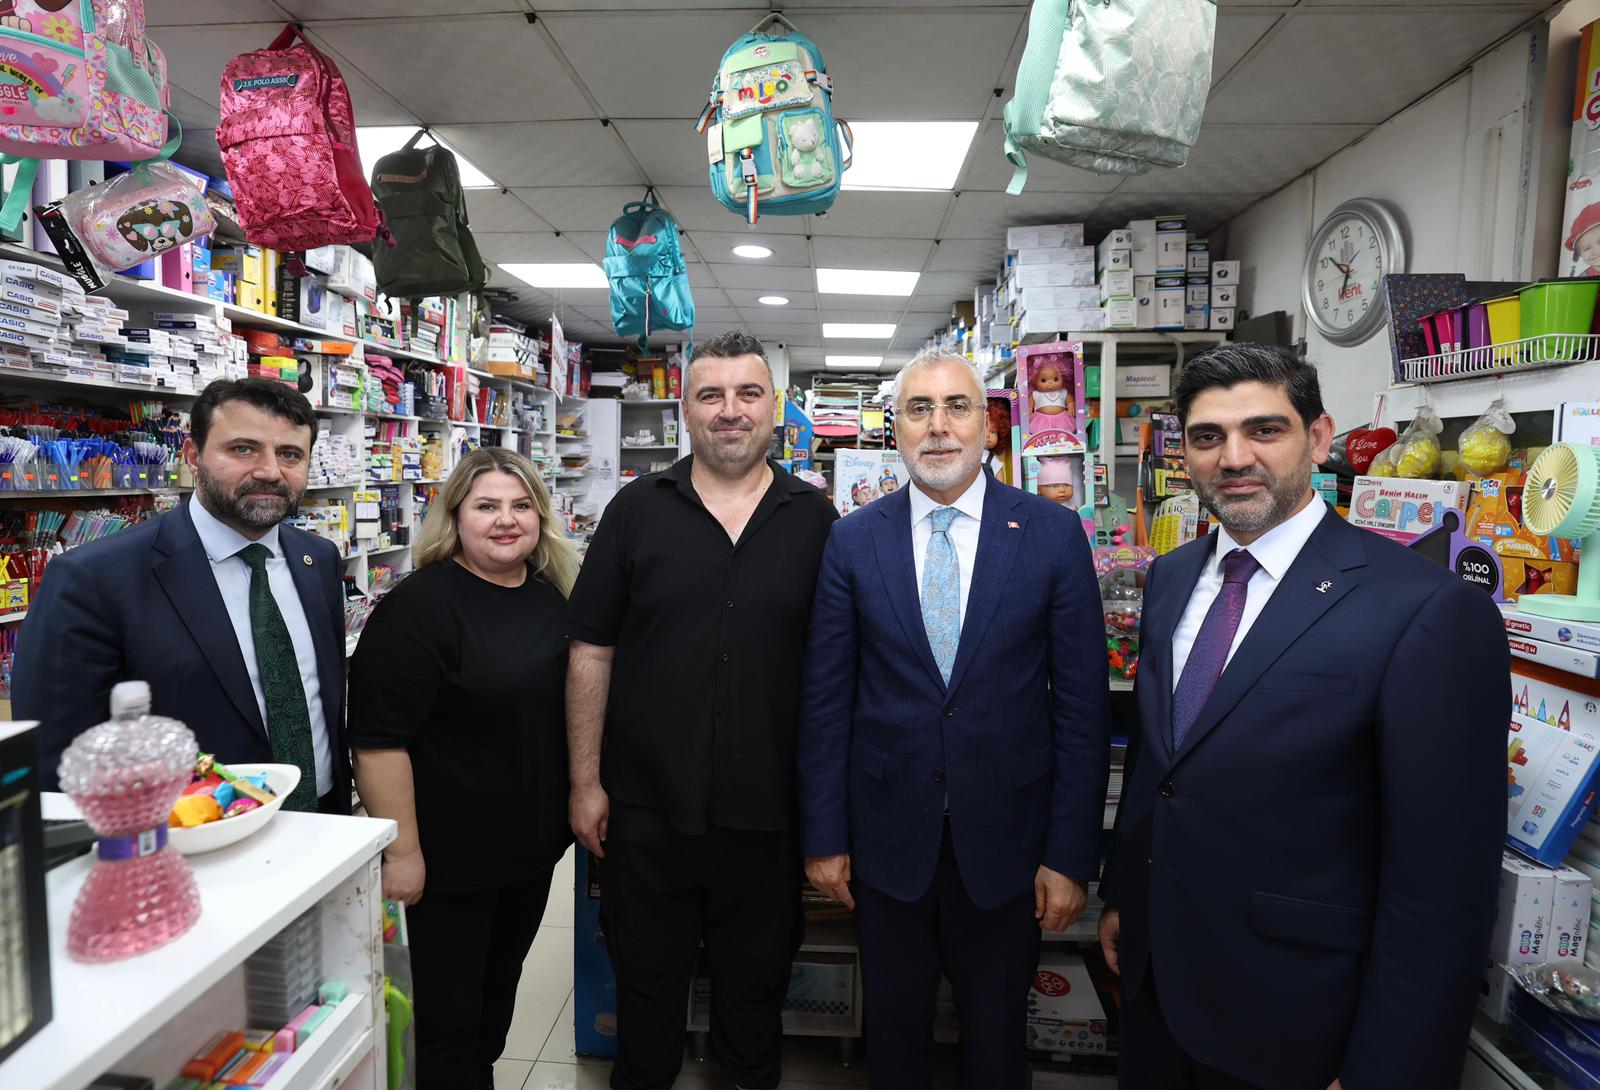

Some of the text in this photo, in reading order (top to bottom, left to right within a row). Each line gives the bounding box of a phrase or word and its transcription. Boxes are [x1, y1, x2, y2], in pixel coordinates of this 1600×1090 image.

[1340, 226, 1350, 240] 12
[1358, 226, 1363, 238] 1
[1328, 240, 1336, 251] 11
[1369, 236, 1376, 250] 2
[1319, 256, 1329, 269] 10
[1376, 256, 1382, 269] 3
[40, 270, 62, 282] CASIO
[6, 277, 34, 290] CASIO
[1317, 280, 1324, 292] 9
[1371, 280, 1378, 290] 4
[7, 291, 34, 303] CASIO
[1323, 298, 1330, 310] 8
[1361, 298, 1368, 312] 5
[1333, 308, 1340, 322] 7
[1347, 309, 1354, 322] 6
[80, 332, 104, 340] CASIO
[840, 455, 875, 470] Disney
[1470, 478, 1499, 490] ARIOCA
[1174, 505, 1184, 514] IQ
[1356, 490, 1444, 530] Carpet
[1497, 540, 1504, 553] 6
[1462, 562, 1490, 574] %100
[1532, 916, 1544, 954] Magnetic
[1570, 918, 1582, 957] Magnetic
